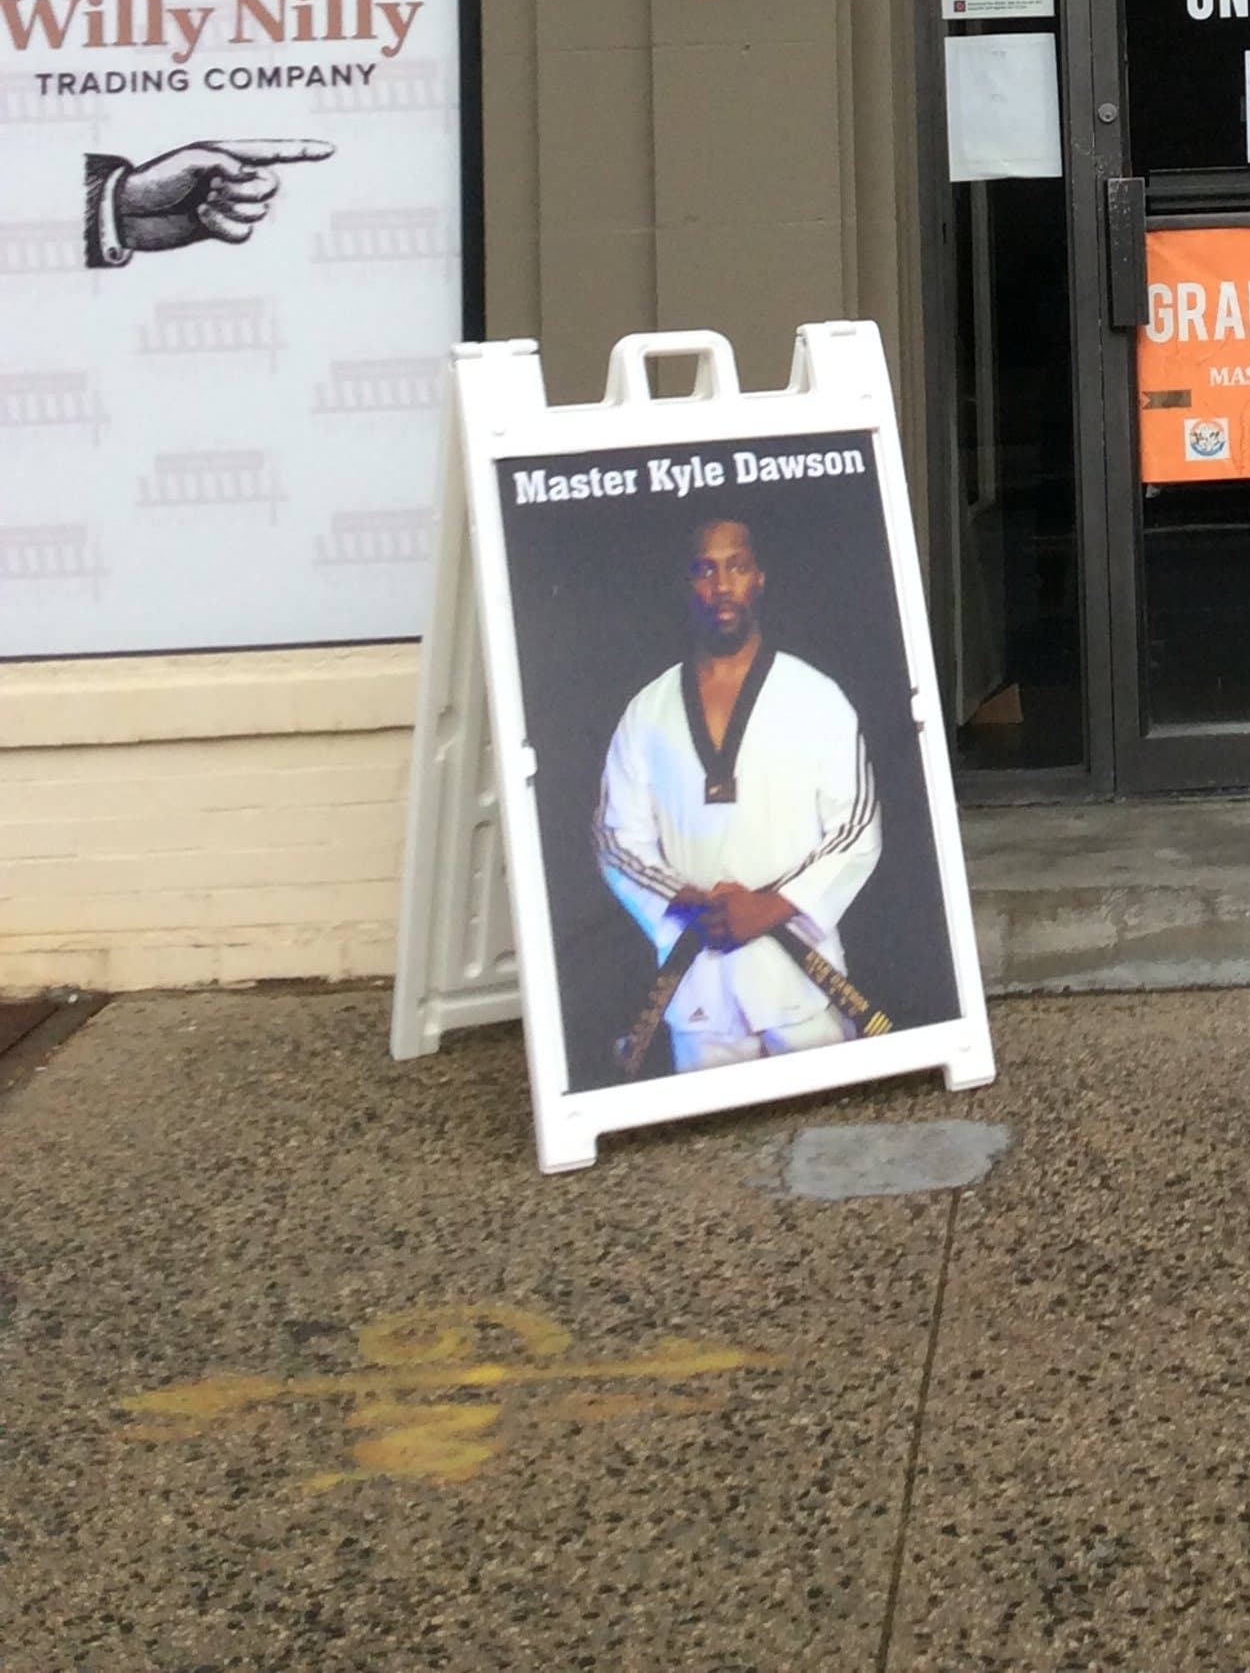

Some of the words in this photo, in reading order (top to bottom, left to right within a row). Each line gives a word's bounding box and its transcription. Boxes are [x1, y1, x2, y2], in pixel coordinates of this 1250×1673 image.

[35, 69, 190, 96] TRADING
[204, 63, 377, 91] COMPANY
[513, 466, 638, 505] Master
[648, 456, 725, 498] Kyle
[732, 449, 866, 485] Dawson
